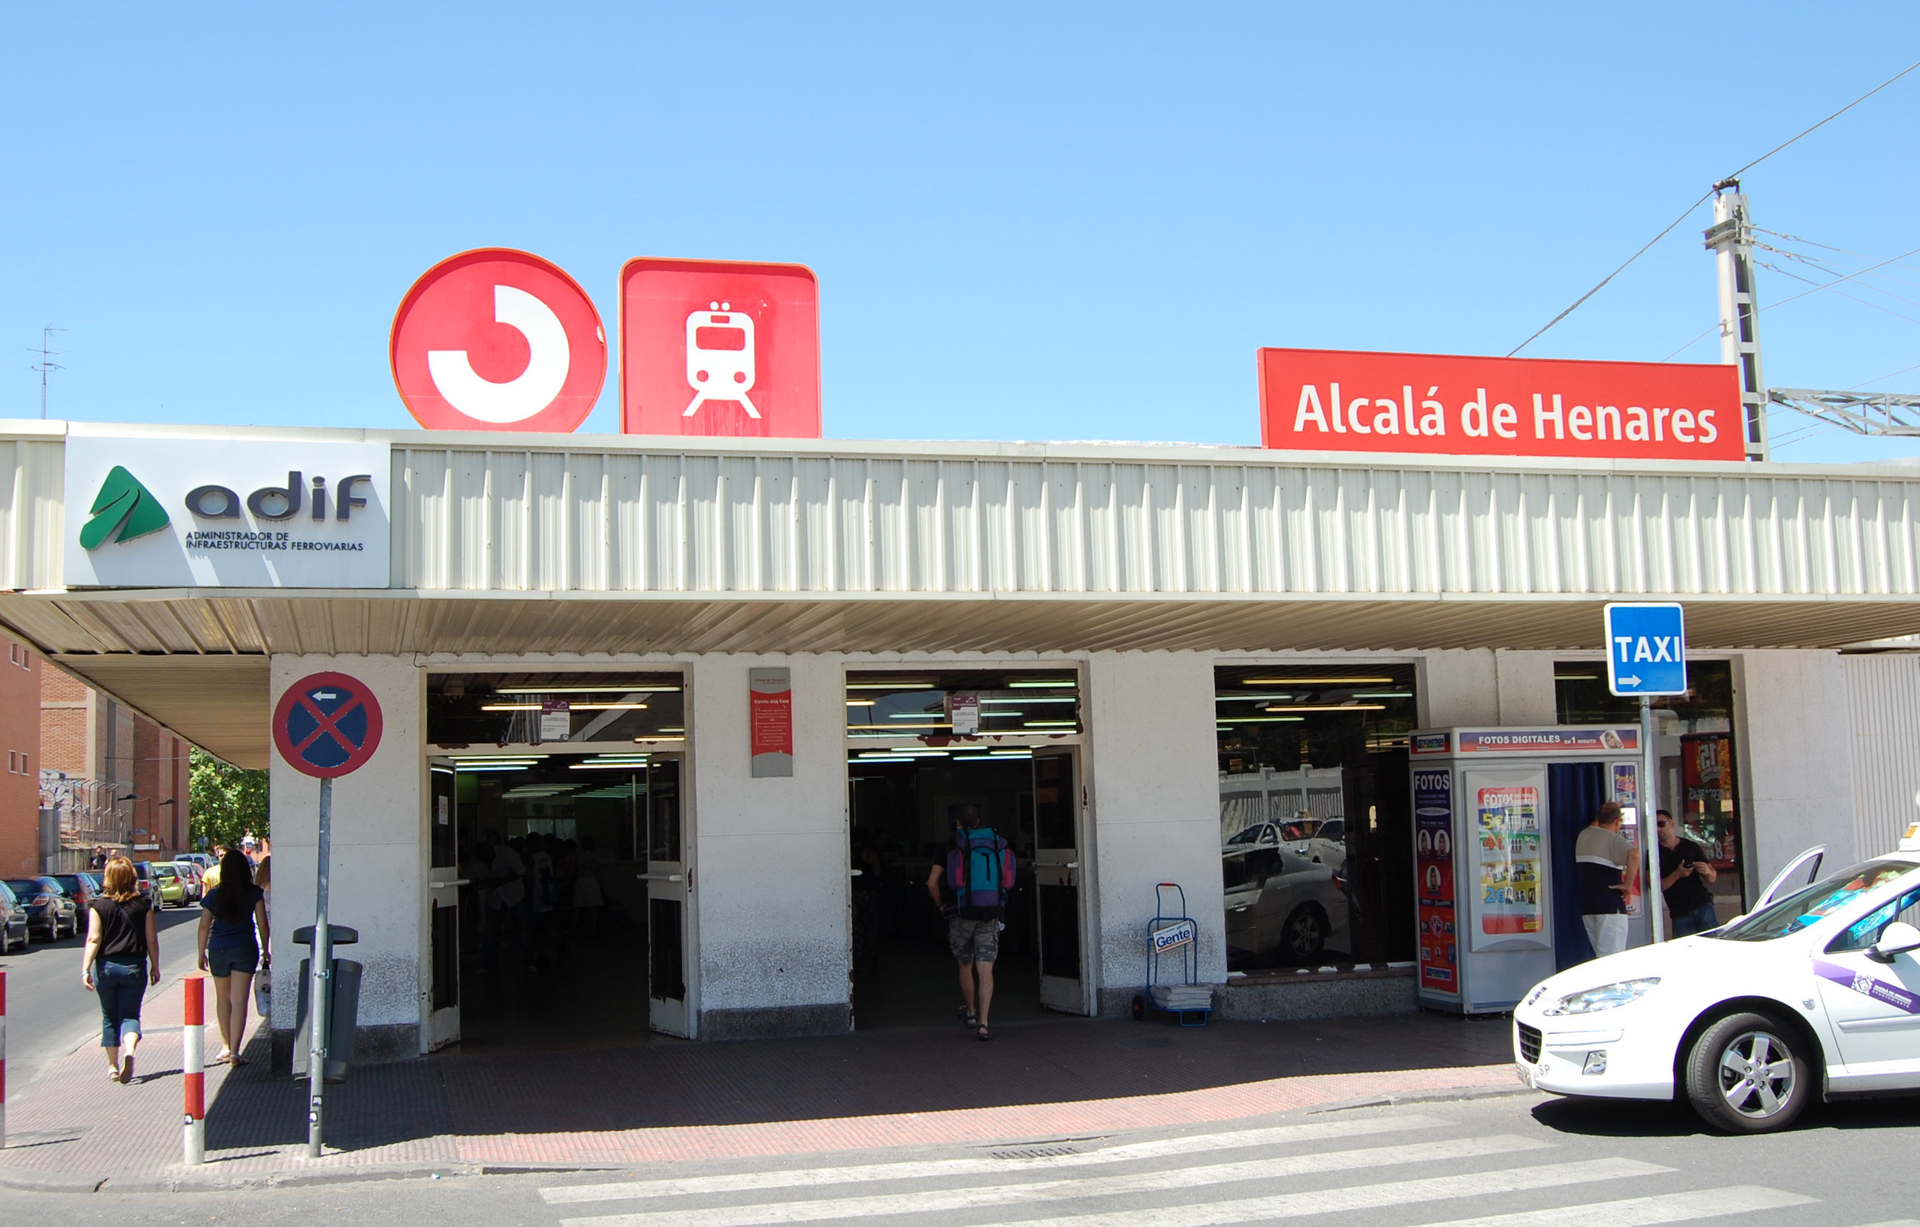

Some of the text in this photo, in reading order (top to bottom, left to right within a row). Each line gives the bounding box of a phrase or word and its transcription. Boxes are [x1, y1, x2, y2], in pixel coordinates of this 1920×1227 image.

[1293, 382, 1718, 444] Alcalá de Henares
[185, 471, 372, 522] adif
[185, 531, 290, 542] ADMINISTRADOR DE
[185, 540, 364, 552] INFRAESTRUCTURAS FERROVIARIAS
[1614, 636, 1681, 663] TAXI
[1478, 736, 1510, 744] FOTOS
[1512, 735, 1560, 744] DIGITALES
[1415, 774, 1450, 790] FOTOS
[1483, 794, 1514, 807] FOTOS
[1484, 888, 1504, 904] 2€
[1156, 930, 1190, 948] Gente
[1538, 1064, 1550, 1076] SP
